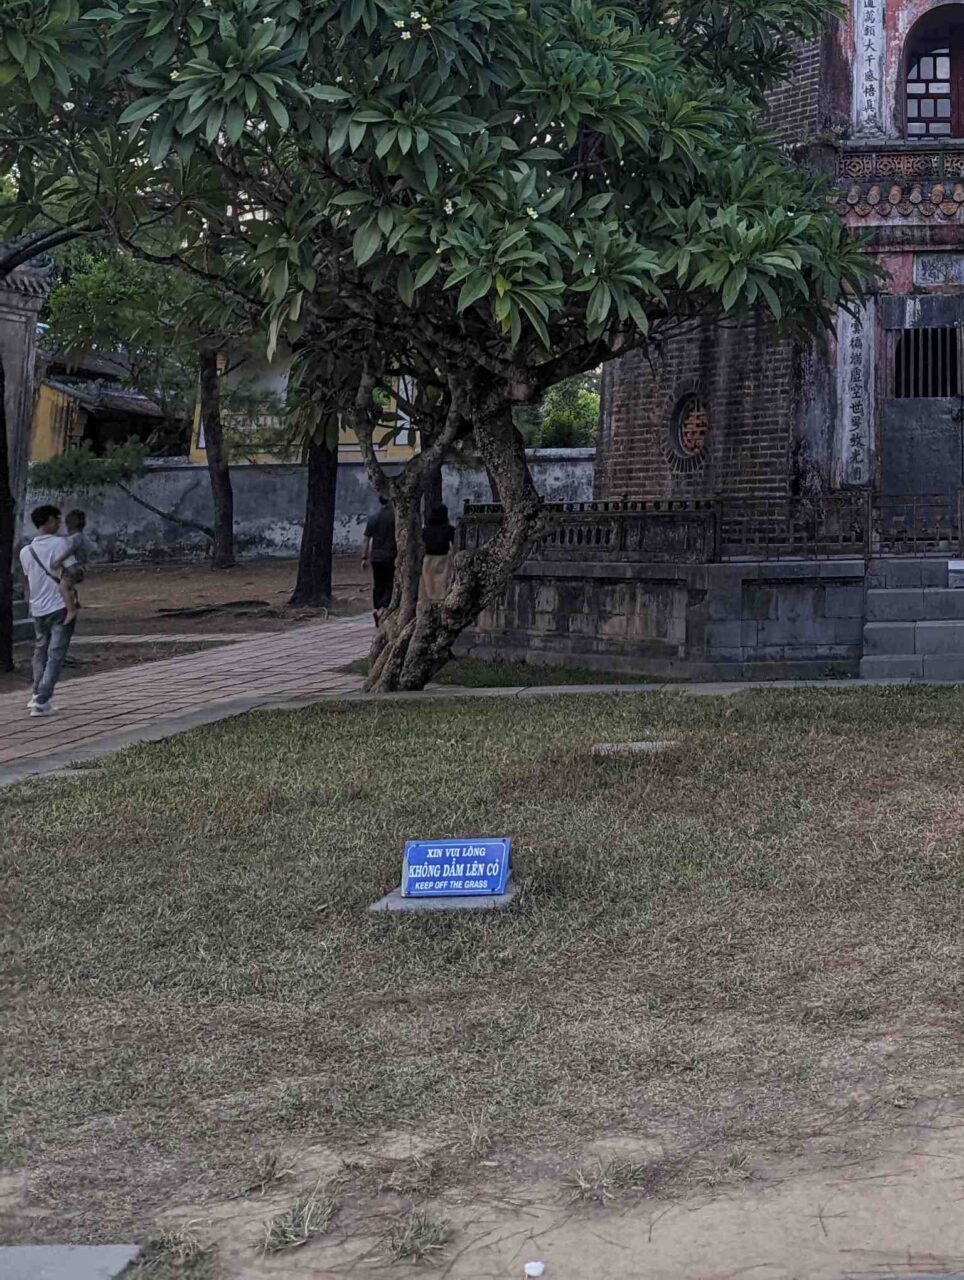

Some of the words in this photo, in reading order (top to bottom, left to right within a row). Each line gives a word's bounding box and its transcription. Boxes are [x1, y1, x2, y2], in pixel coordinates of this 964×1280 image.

[427, 848, 443, 858] XIN
[445, 848, 460, 858] VUI
[409, 861, 441, 878] KHÔNG
[465, 860, 485, 877] LÊN
[486, 858, 499, 876] CỎ
[415, 881, 434, 890] KEEP
[435, 881, 449, 889] OFF
[450, 880, 463, 888] THE
[464, 879, 488, 888] GRASS
